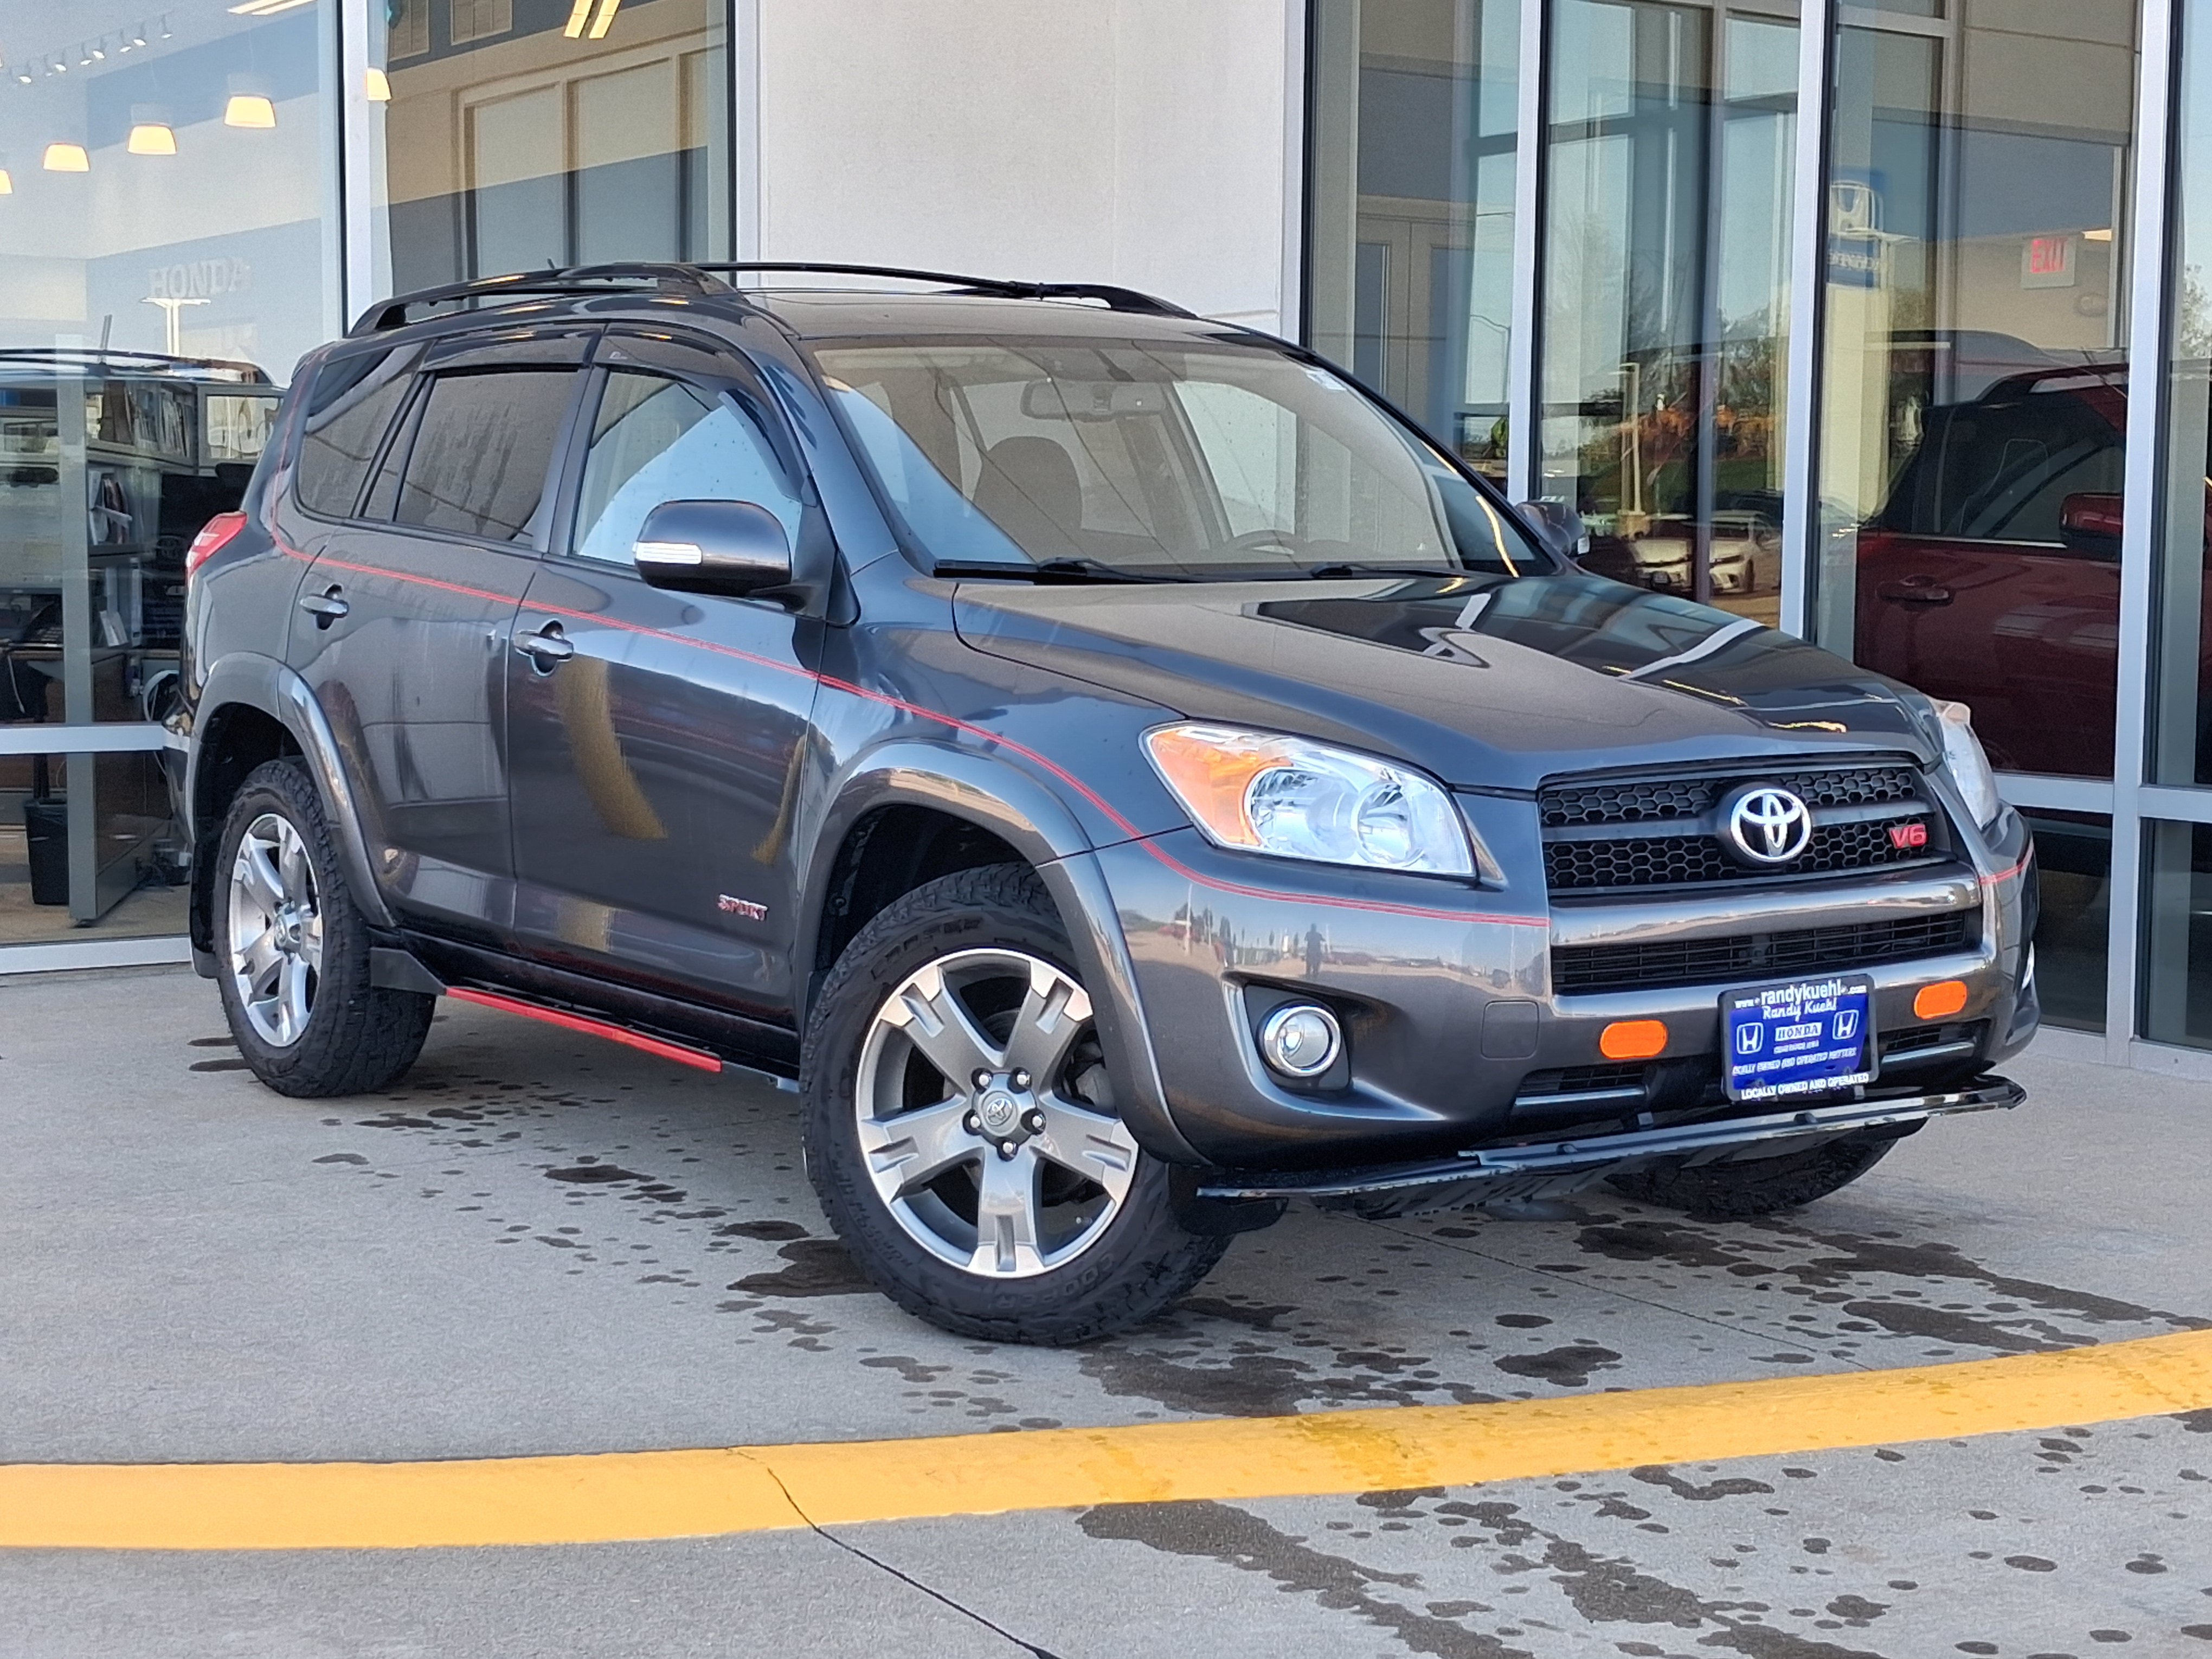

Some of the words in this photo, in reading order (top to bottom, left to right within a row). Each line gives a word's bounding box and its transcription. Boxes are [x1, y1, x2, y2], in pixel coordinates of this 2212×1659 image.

[2030, 239, 2065, 273] EXIT
[148, 256, 251, 298] HONDA
[1889, 824, 1927, 849] V6
[1763, 1004, 1801, 1022] Randy
[1804, 998, 1837, 1014] Kuehl
[1777, 1024, 1819, 1039] HONDA
[1741, 1085, 1777, 1100] LOCALLY
[1778, 1081, 1808, 1095] OWNED
[1809, 1078, 1827, 1091] AND
[1827, 1072, 1869, 1088] OPERATED
